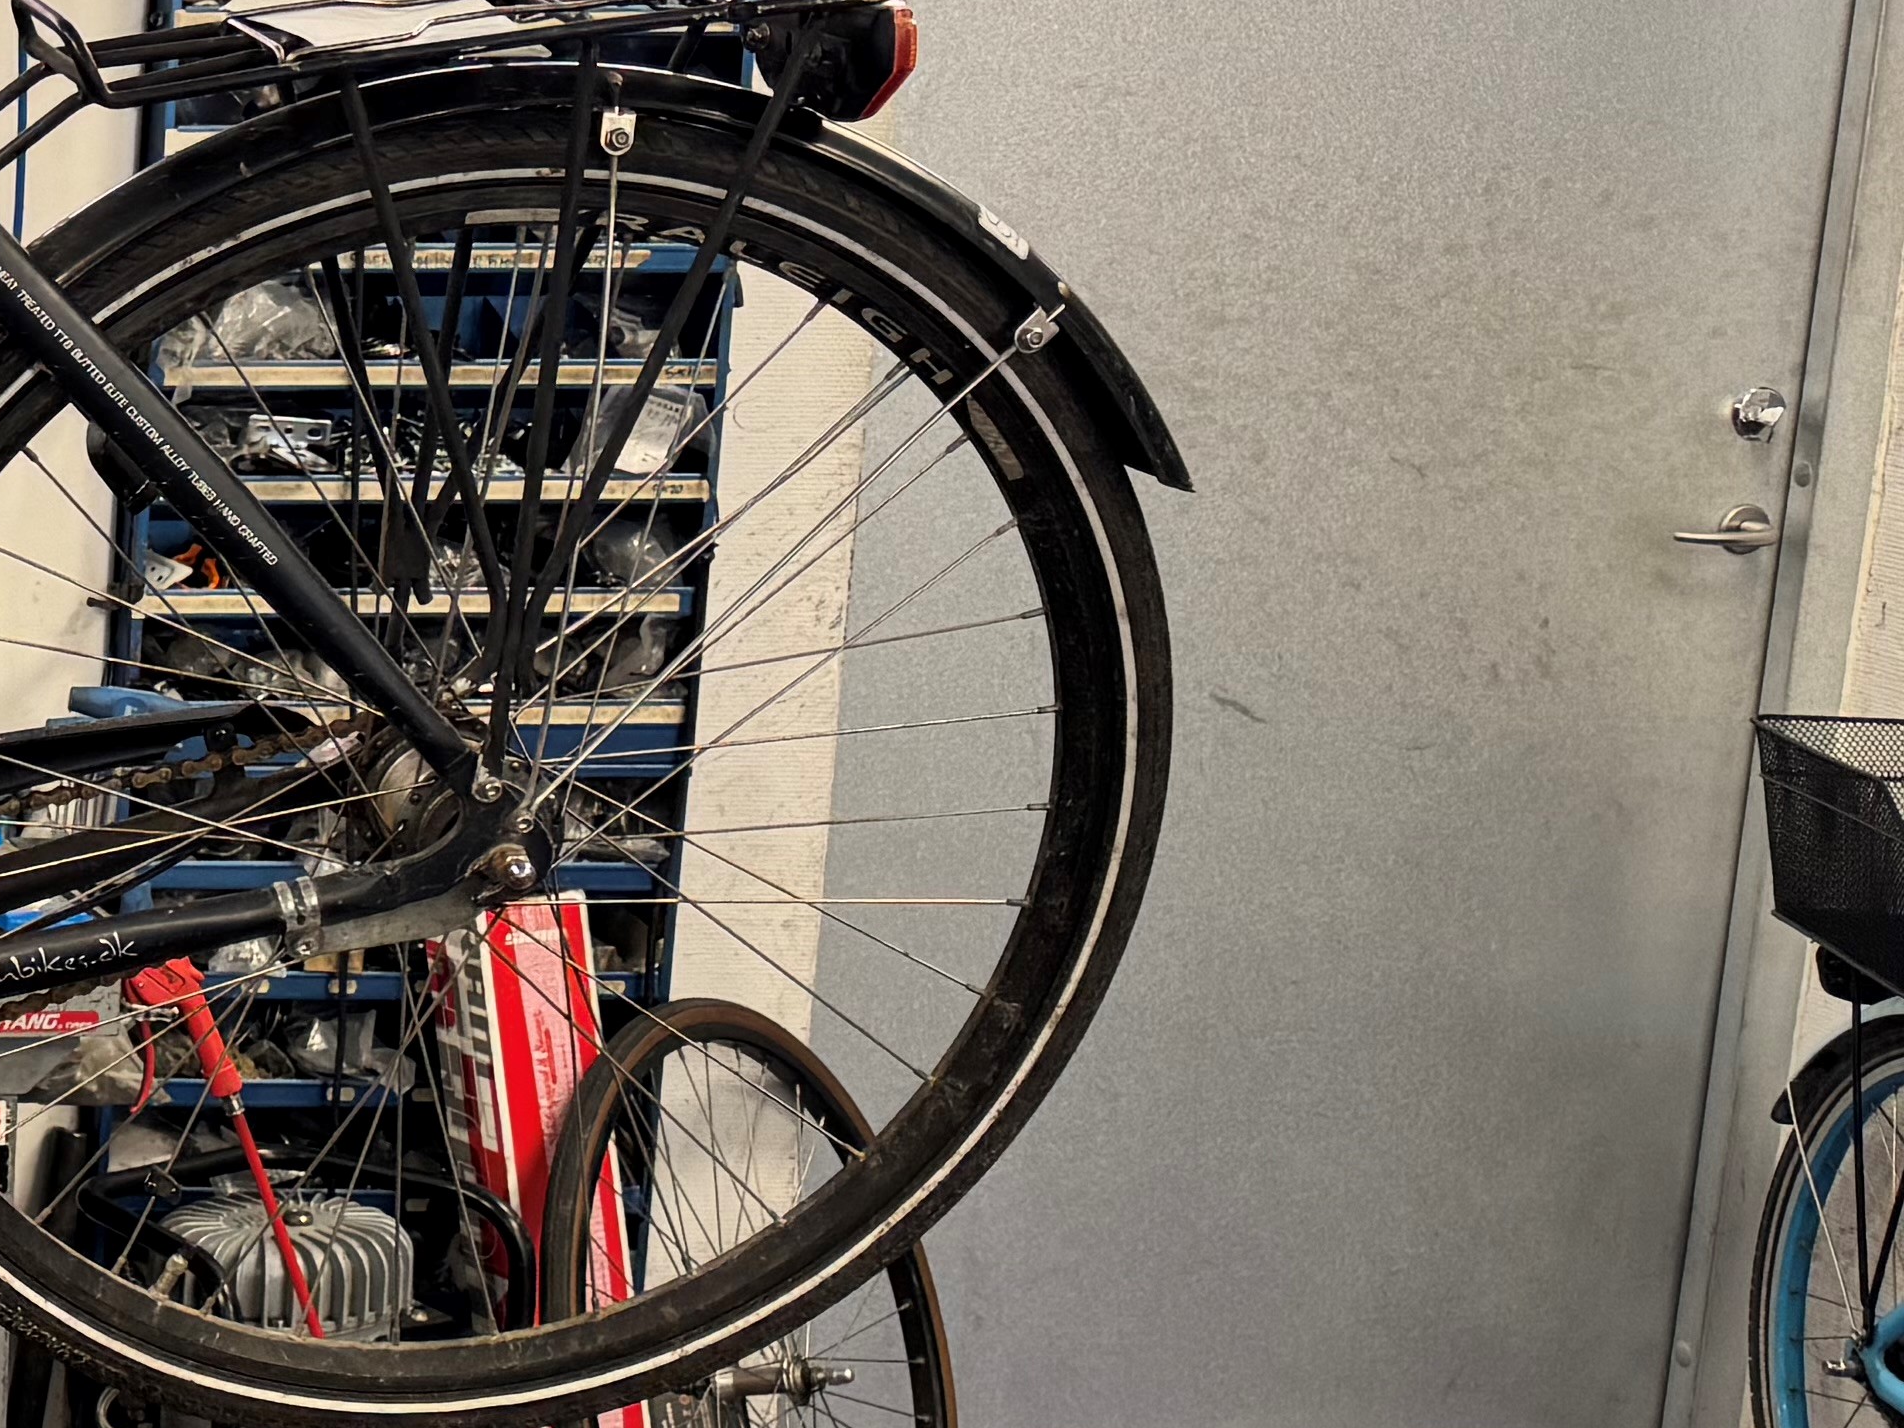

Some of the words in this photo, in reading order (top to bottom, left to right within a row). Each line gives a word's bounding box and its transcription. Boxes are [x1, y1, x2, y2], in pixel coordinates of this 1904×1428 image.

[17, 288, 56, 331] TREATED
[125, 405, 164, 446] CUSTOM
[160, 444, 191, 472] ALLOY
[238, 524, 279, 566] CRAFTED
